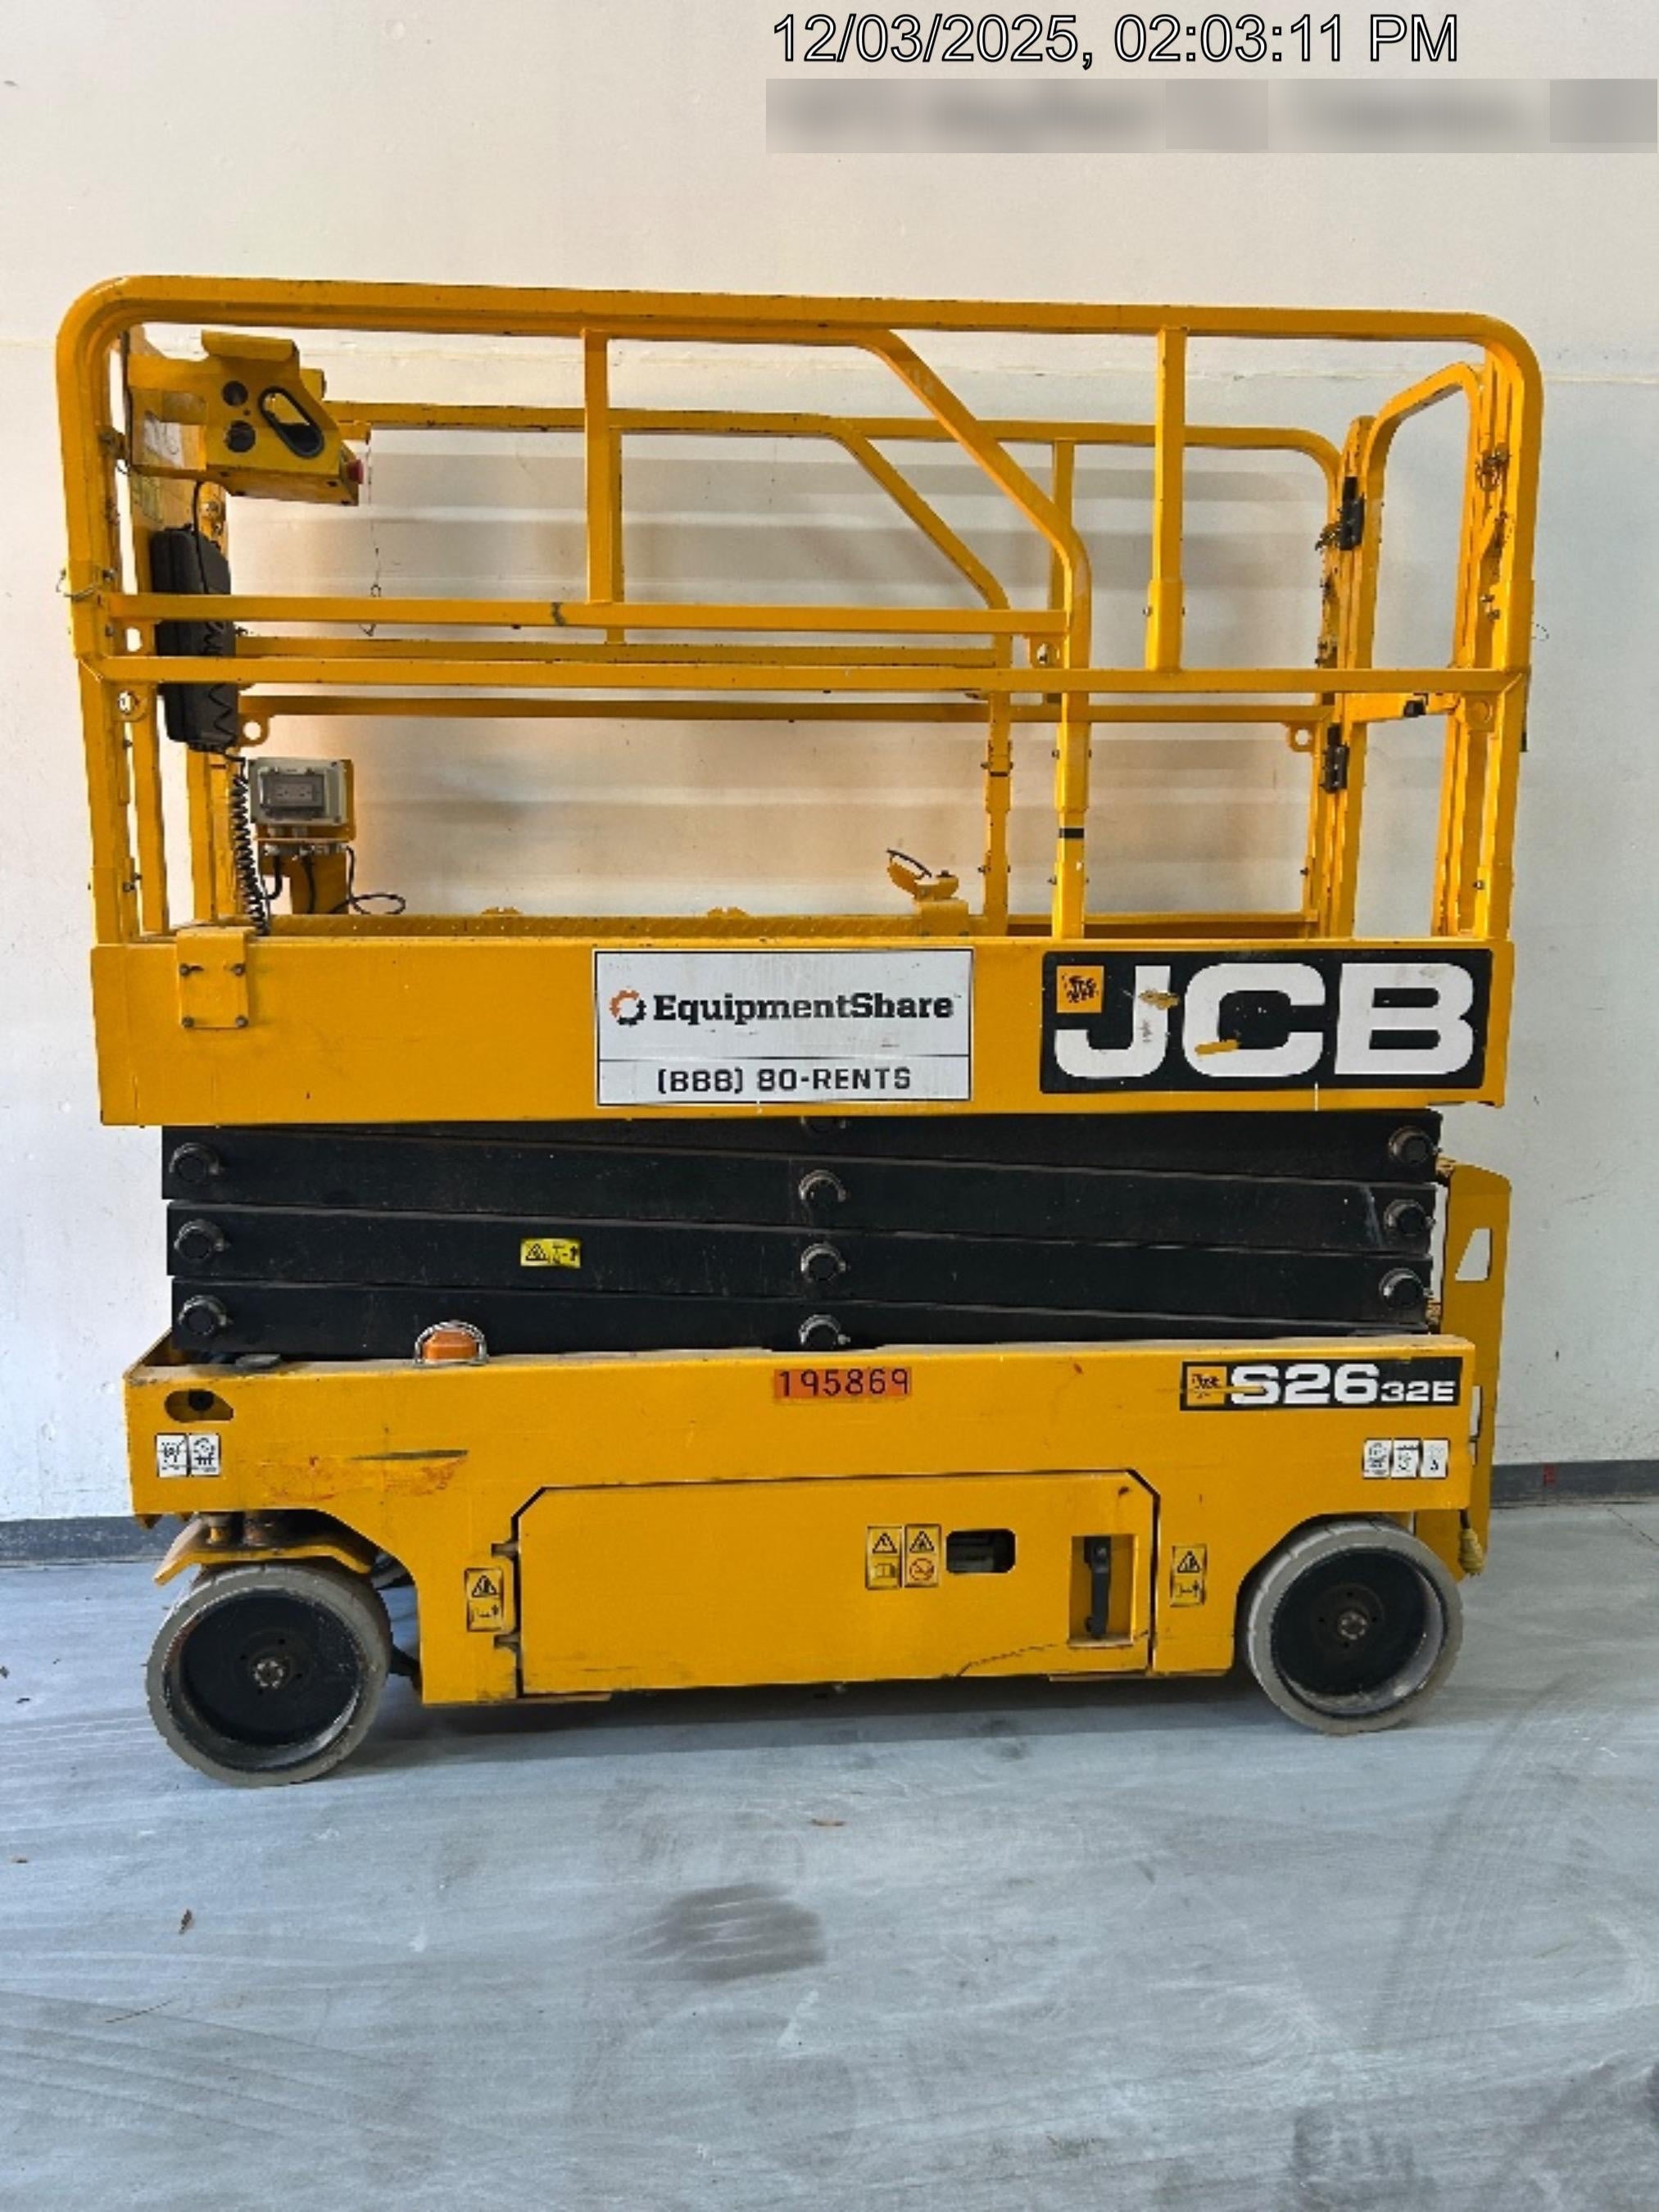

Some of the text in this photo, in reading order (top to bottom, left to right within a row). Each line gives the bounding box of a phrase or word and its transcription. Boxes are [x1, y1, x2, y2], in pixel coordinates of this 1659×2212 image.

[653, 992, 954, 1027] EquipmentShare
[1054, 963, 1475, 1078] JCB
[658, 1067, 911, 1095] (888) 80-RENTS
[779, 1367, 909, 1398] 195869
[1231, 1363, 1379, 1404] S26
[1380, 1380, 1456, 1403] 32E
